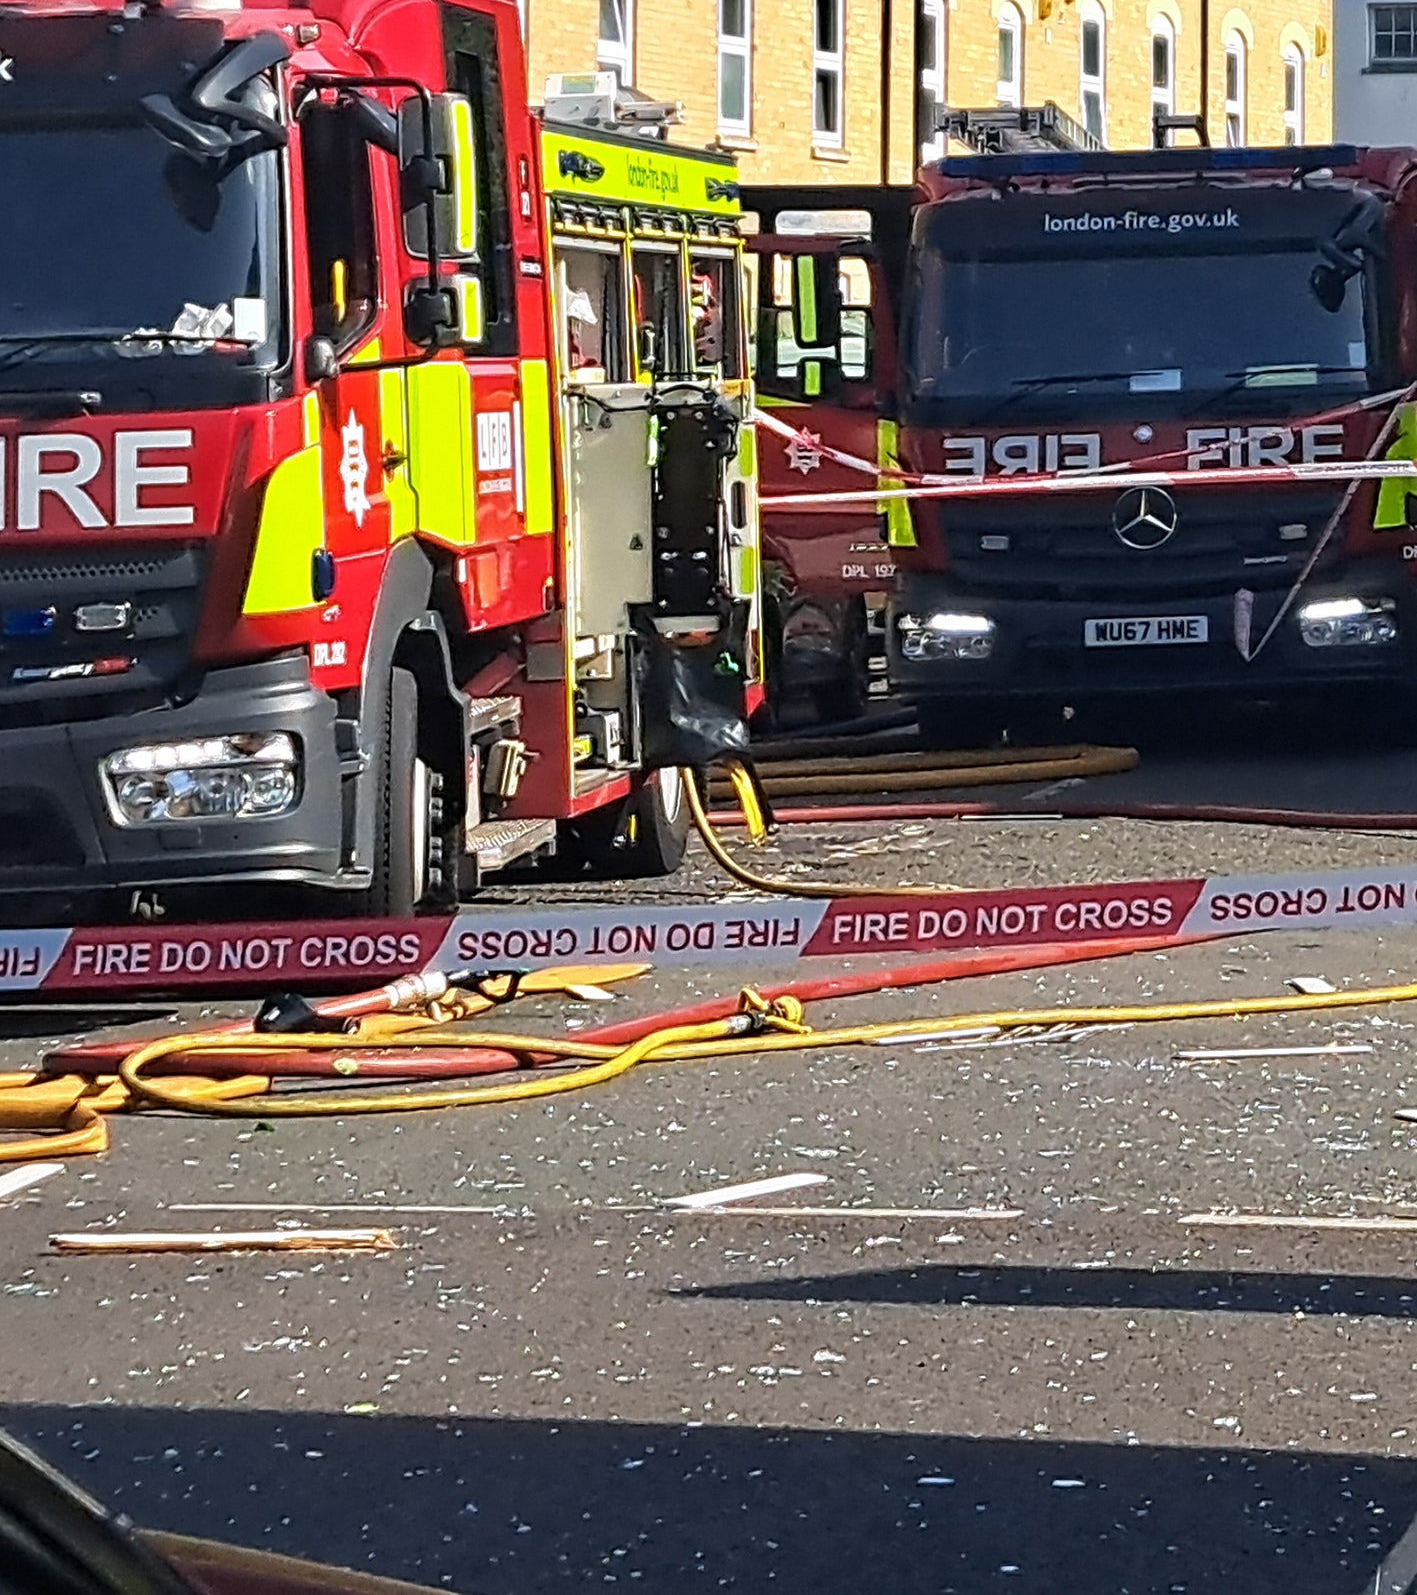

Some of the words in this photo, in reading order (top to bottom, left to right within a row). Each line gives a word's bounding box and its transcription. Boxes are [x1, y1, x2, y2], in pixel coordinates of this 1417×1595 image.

[1043, 208, 1240, 233] london-fire.gov.uk
[1186, 424, 1344, 471] FIRE
[0, 430, 194, 531] RE
[842, 564, 870, 578] DPL
[1095, 620, 1151, 642] WU67
[1157, 619, 1200, 639] HME
[1210, 887, 1327, 921] CROSS
[1335, 883, 1406, 913] NOT
[666, 921, 714, 951] DO
[724, 917, 800, 948] FIRE
[832, 912, 909, 944] FIRE
[917, 909, 967, 939] DO
[975, 905, 1048, 936] NOT
[1054, 897, 1172, 932] CROSS
[73, 943, 150, 975] FIRE
[160, 941, 211, 972] DO
[218, 938, 293, 970] NOT
[300, 934, 420, 967] CROSS
[458, 928, 577, 960] CROSS
[585, 924, 656, 954] NOT
